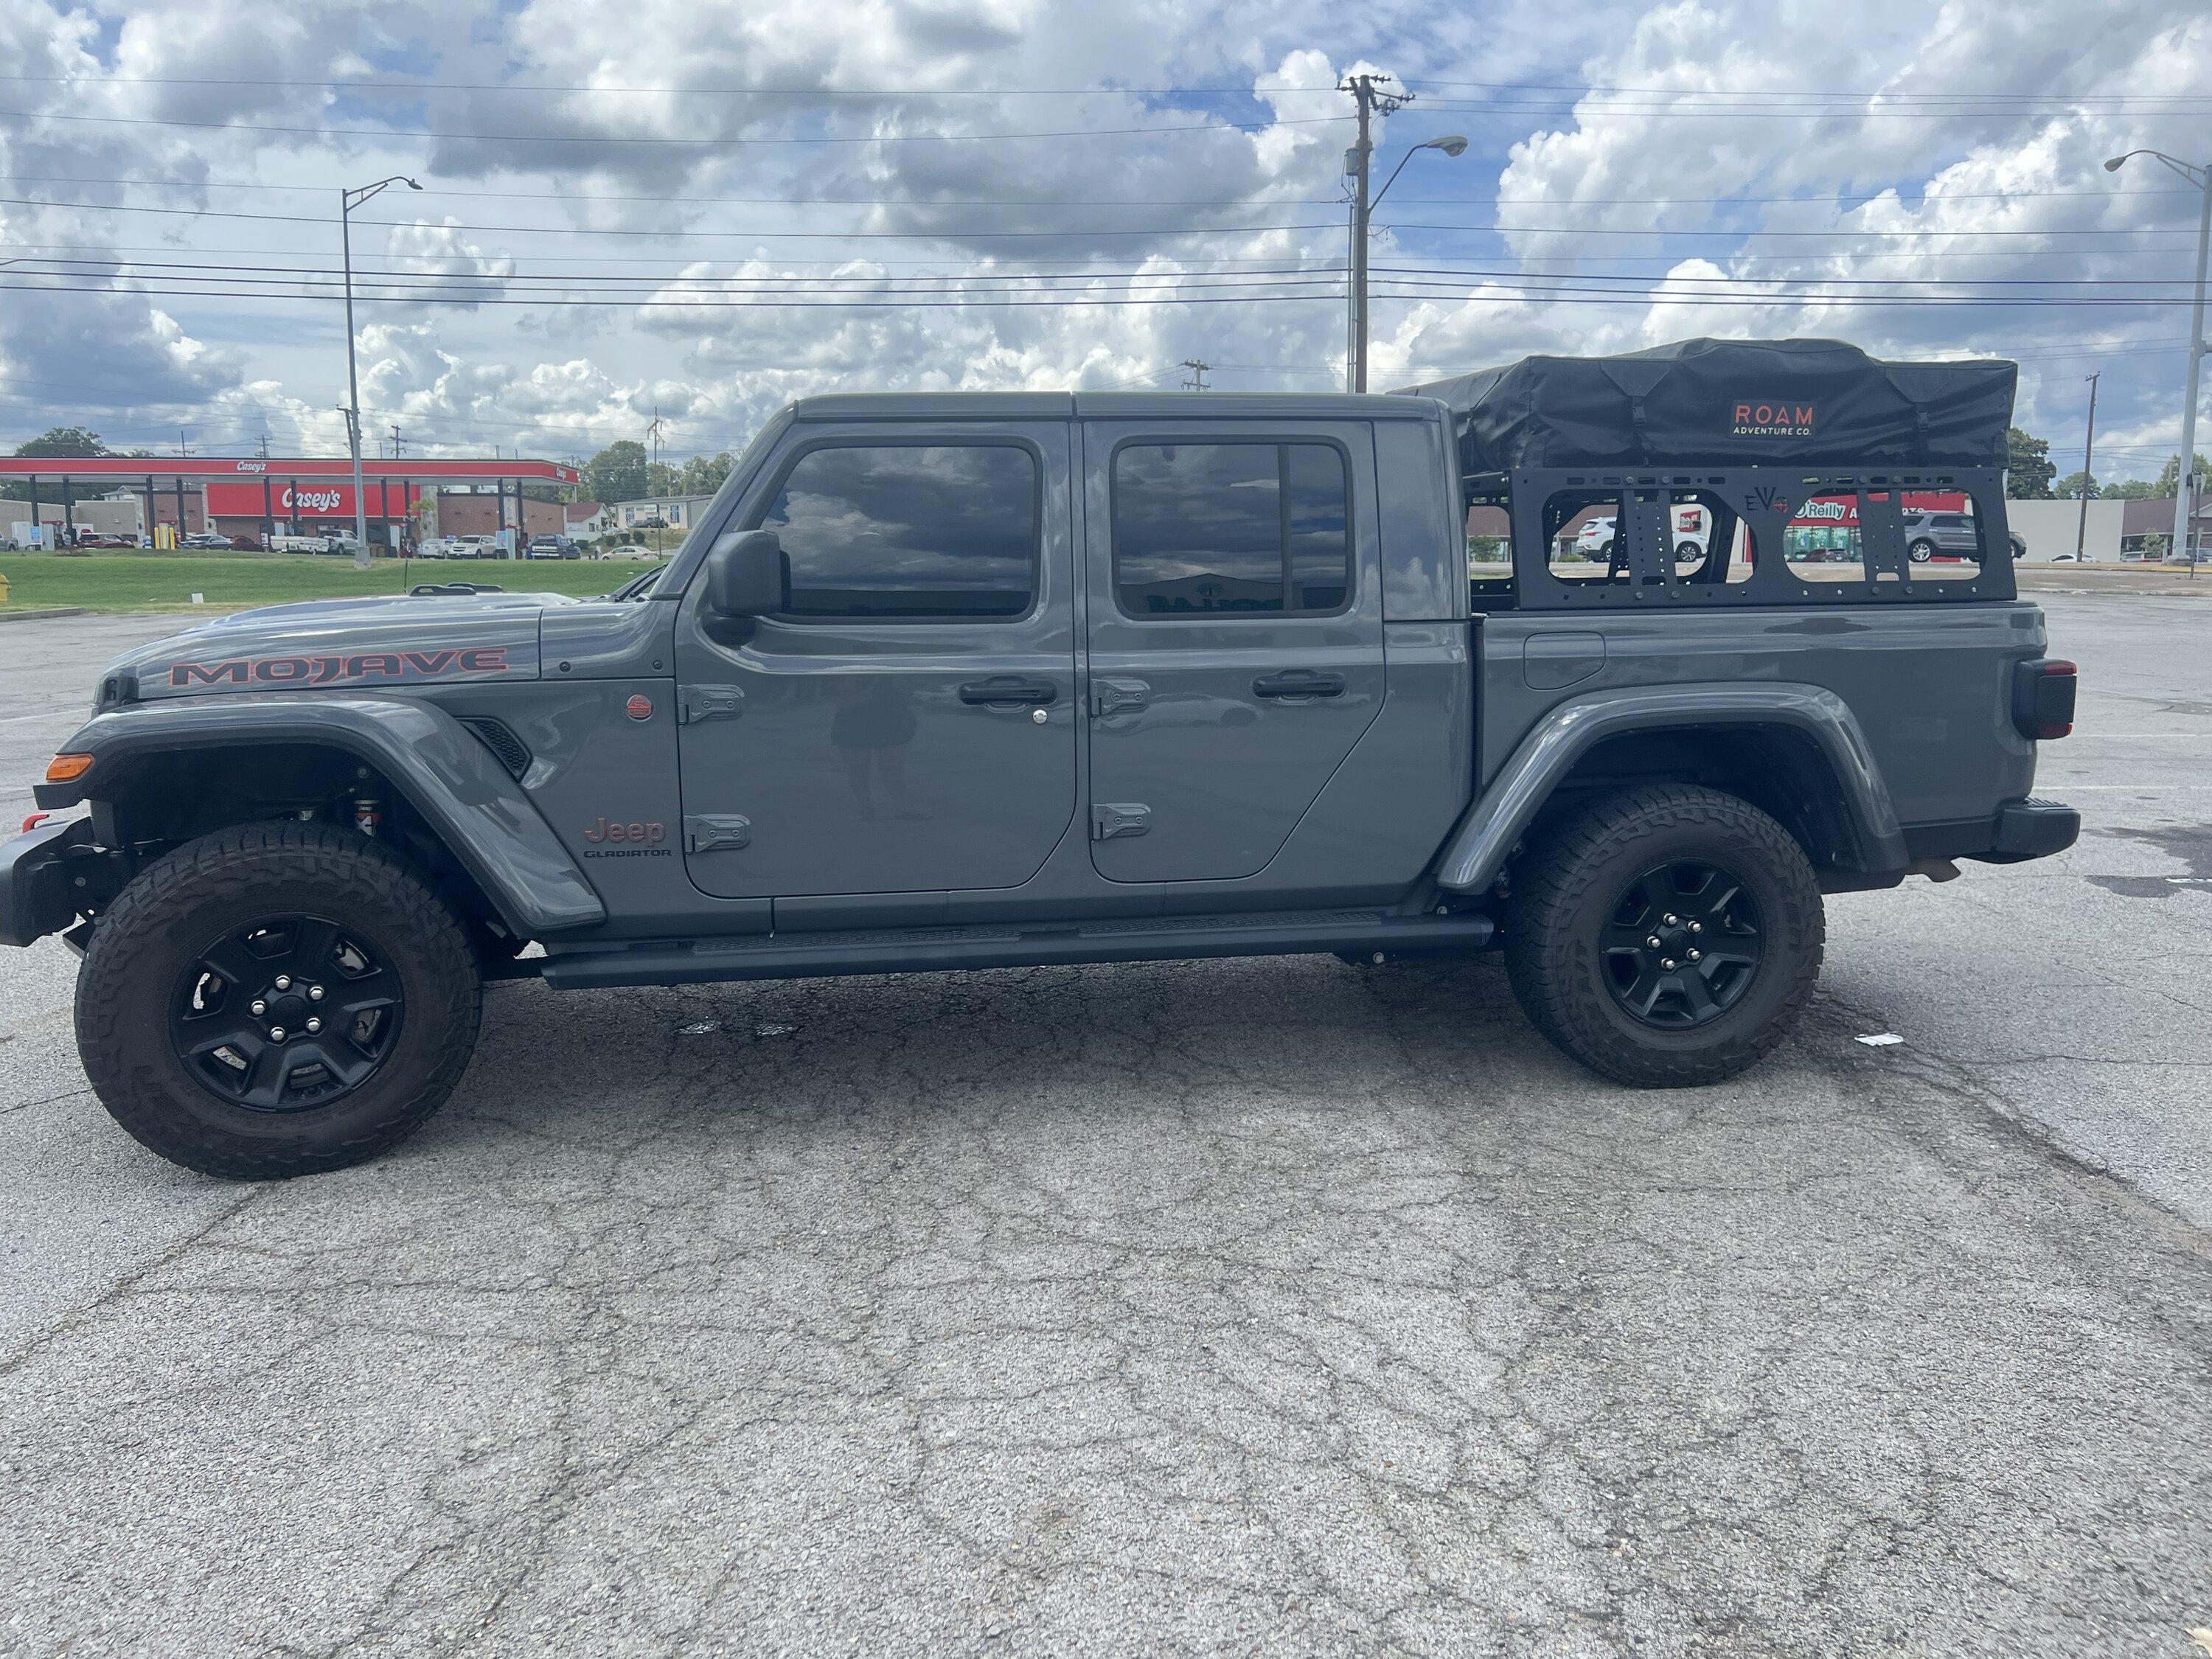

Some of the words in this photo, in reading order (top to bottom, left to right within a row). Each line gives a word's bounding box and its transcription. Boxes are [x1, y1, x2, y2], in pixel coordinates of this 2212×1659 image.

[1735, 405, 1813, 425] ROAM
[1733, 426, 1793, 435] ADVENTURE
[1796, 428, 1811, 436] CO.
[236, 461, 266, 473] Casey's
[282, 487, 341, 512] Casey's
[169, 648, 508, 686] MOJAVE
[585, 817, 666, 847] Jeep
[584, 849, 672, 858] GLADIATOR
